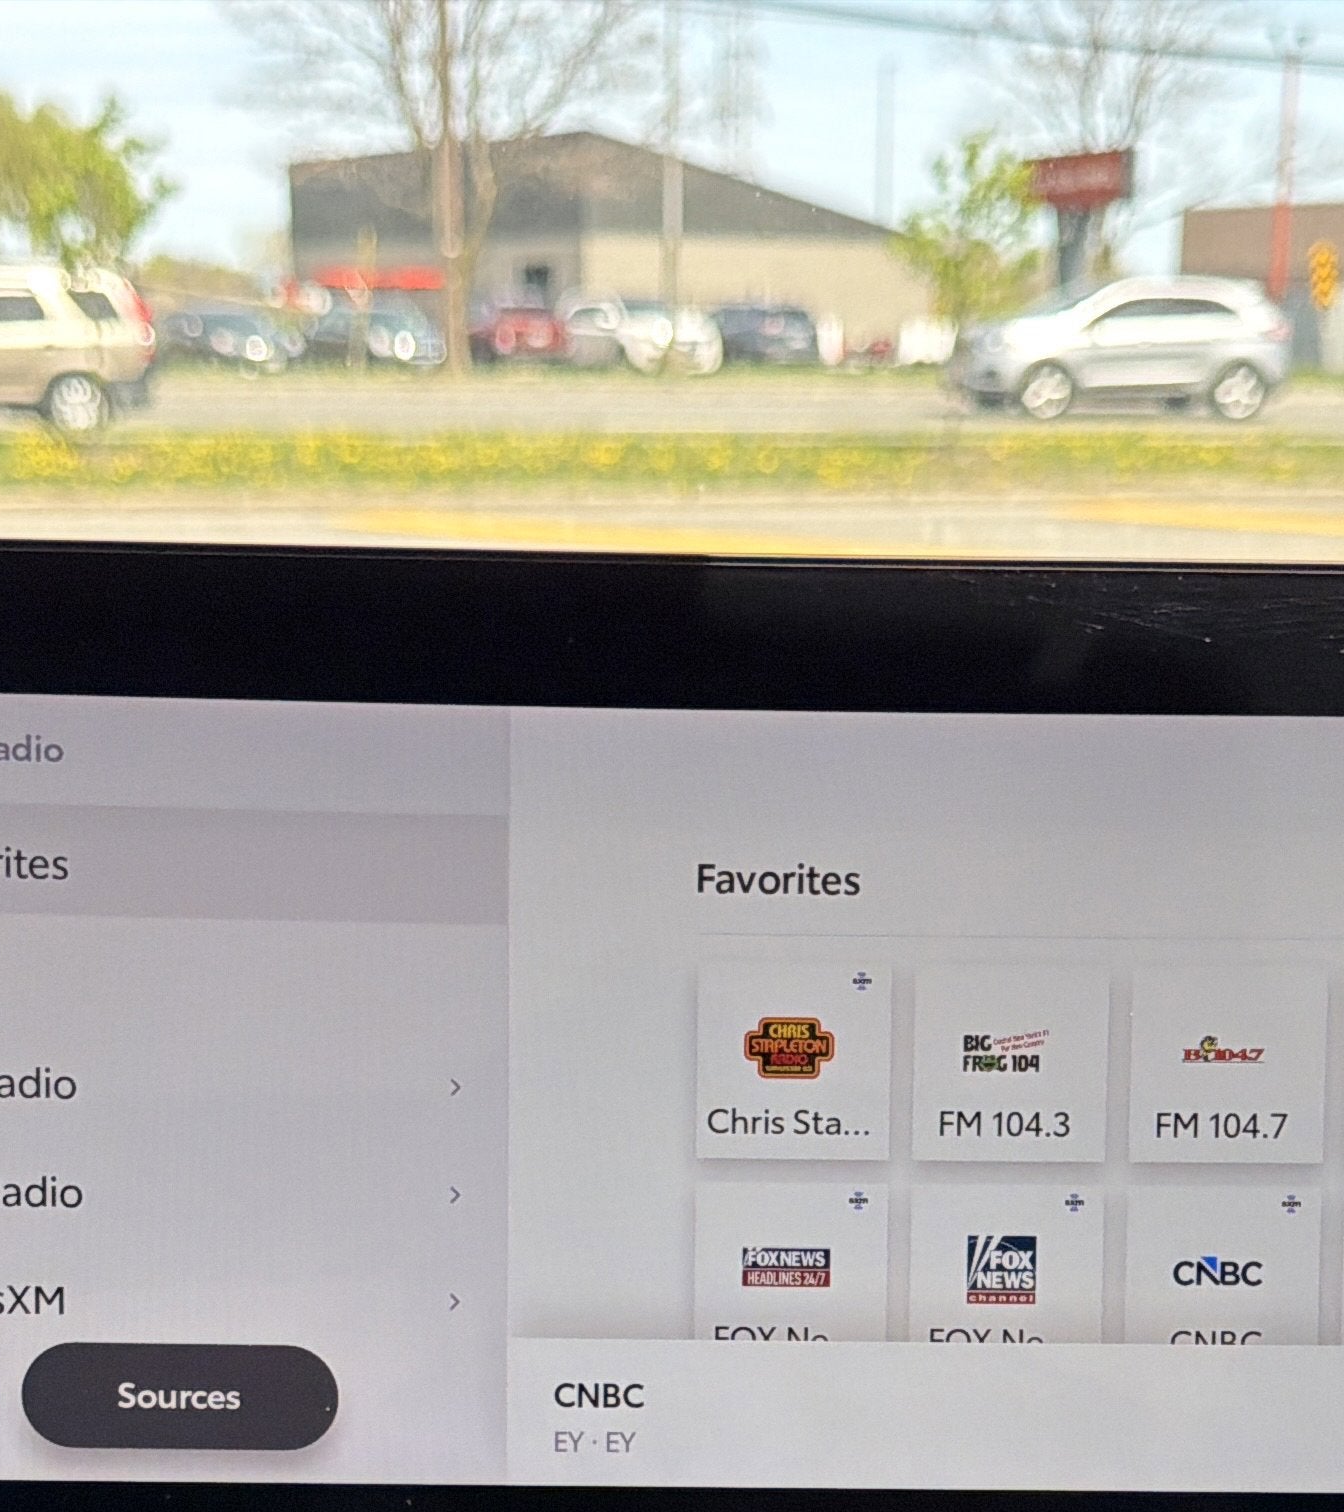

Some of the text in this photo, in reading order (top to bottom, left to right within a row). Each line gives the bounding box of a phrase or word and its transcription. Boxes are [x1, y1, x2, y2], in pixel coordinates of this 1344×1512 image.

[697, 863, 861, 896] Favorites
[768, 1023, 811, 1039] CHRIS
[751, 1038, 827, 1054] STAPLETON
[963, 1035, 992, 1053] BIG
[1011, 1055, 1040, 1073] 104
[707, 1109, 784, 1135] Chris
[939, 1110, 1070, 1137] FM 104.3
[1155, 1113, 1289, 1140] FM 104.7
[990, 1250, 1034, 1270] FOX
[747, 1271, 826, 1287] HEADLINES 24/7
[976, 1271, 1035, 1290] NEWS
[1172, 1257, 1264, 1287] CNBC
[117, 1382, 241, 1410] Sources
[554, 1383, 645, 1408] CNBC
[554, 1431, 584, 1453] EY
[606, 1431, 636, 1453] EY
